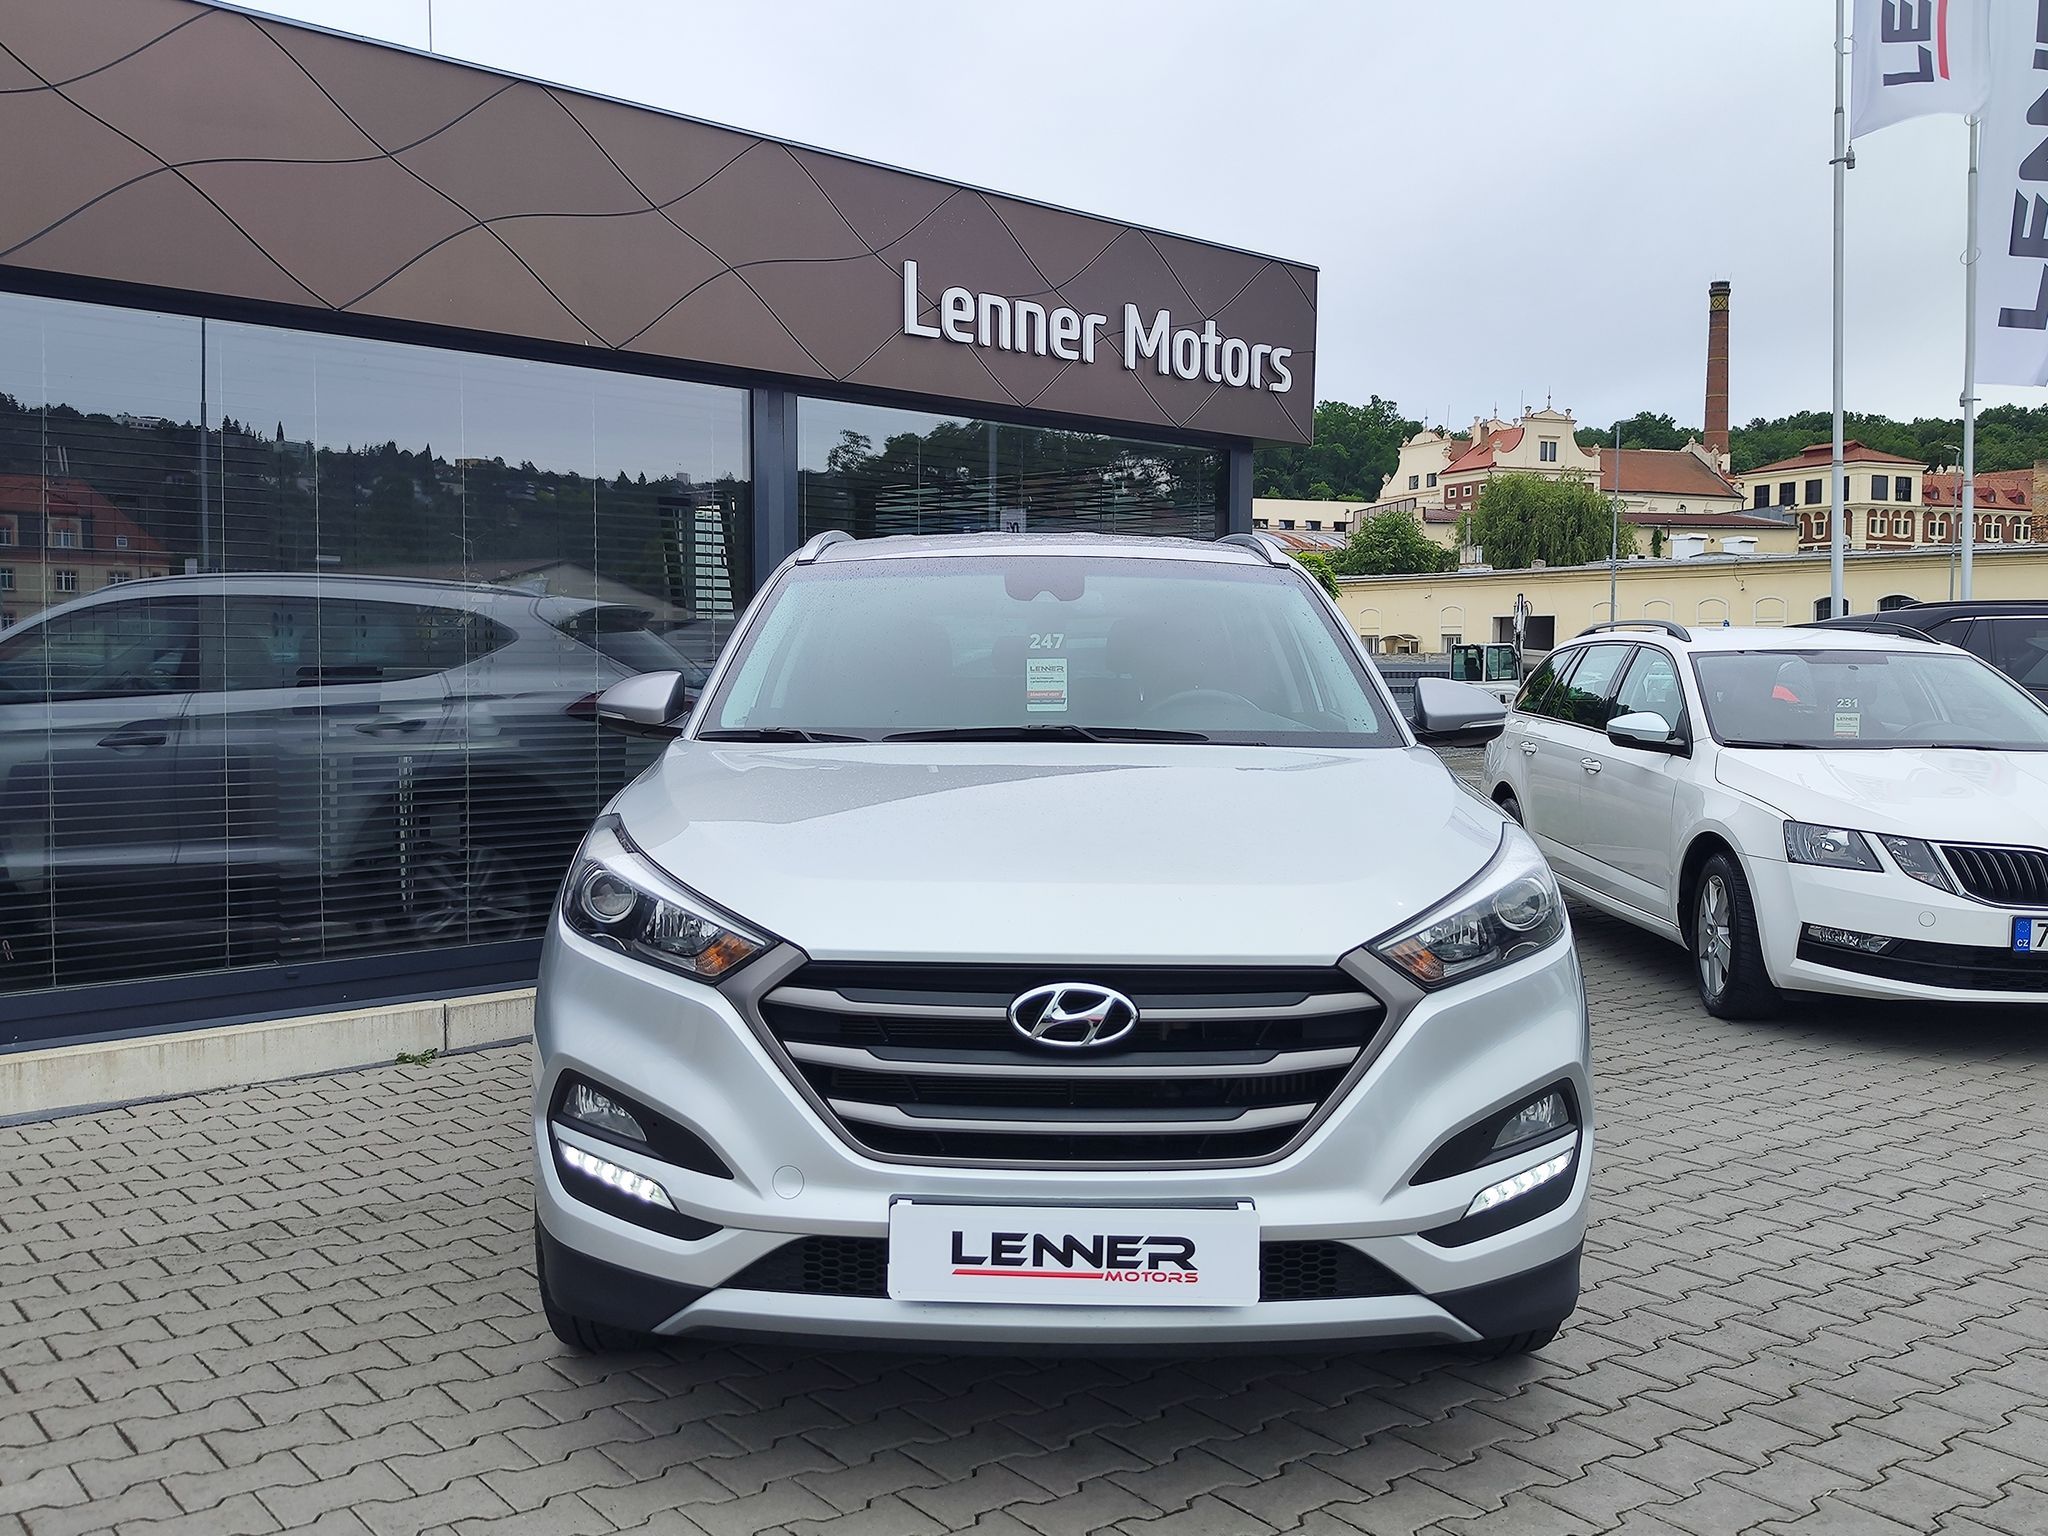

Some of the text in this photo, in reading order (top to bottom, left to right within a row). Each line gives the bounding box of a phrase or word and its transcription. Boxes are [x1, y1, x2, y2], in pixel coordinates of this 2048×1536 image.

[903, 259, 1293, 393] Lenner Motors
[1029, 633, 1064, 649] 247
[1836, 698, 1858, 708] 231
[2016, 938, 2029, 947] CZ
[951, 1230, 1199, 1271] LENNER
[1104, 1270, 1199, 1284] MOTORS
